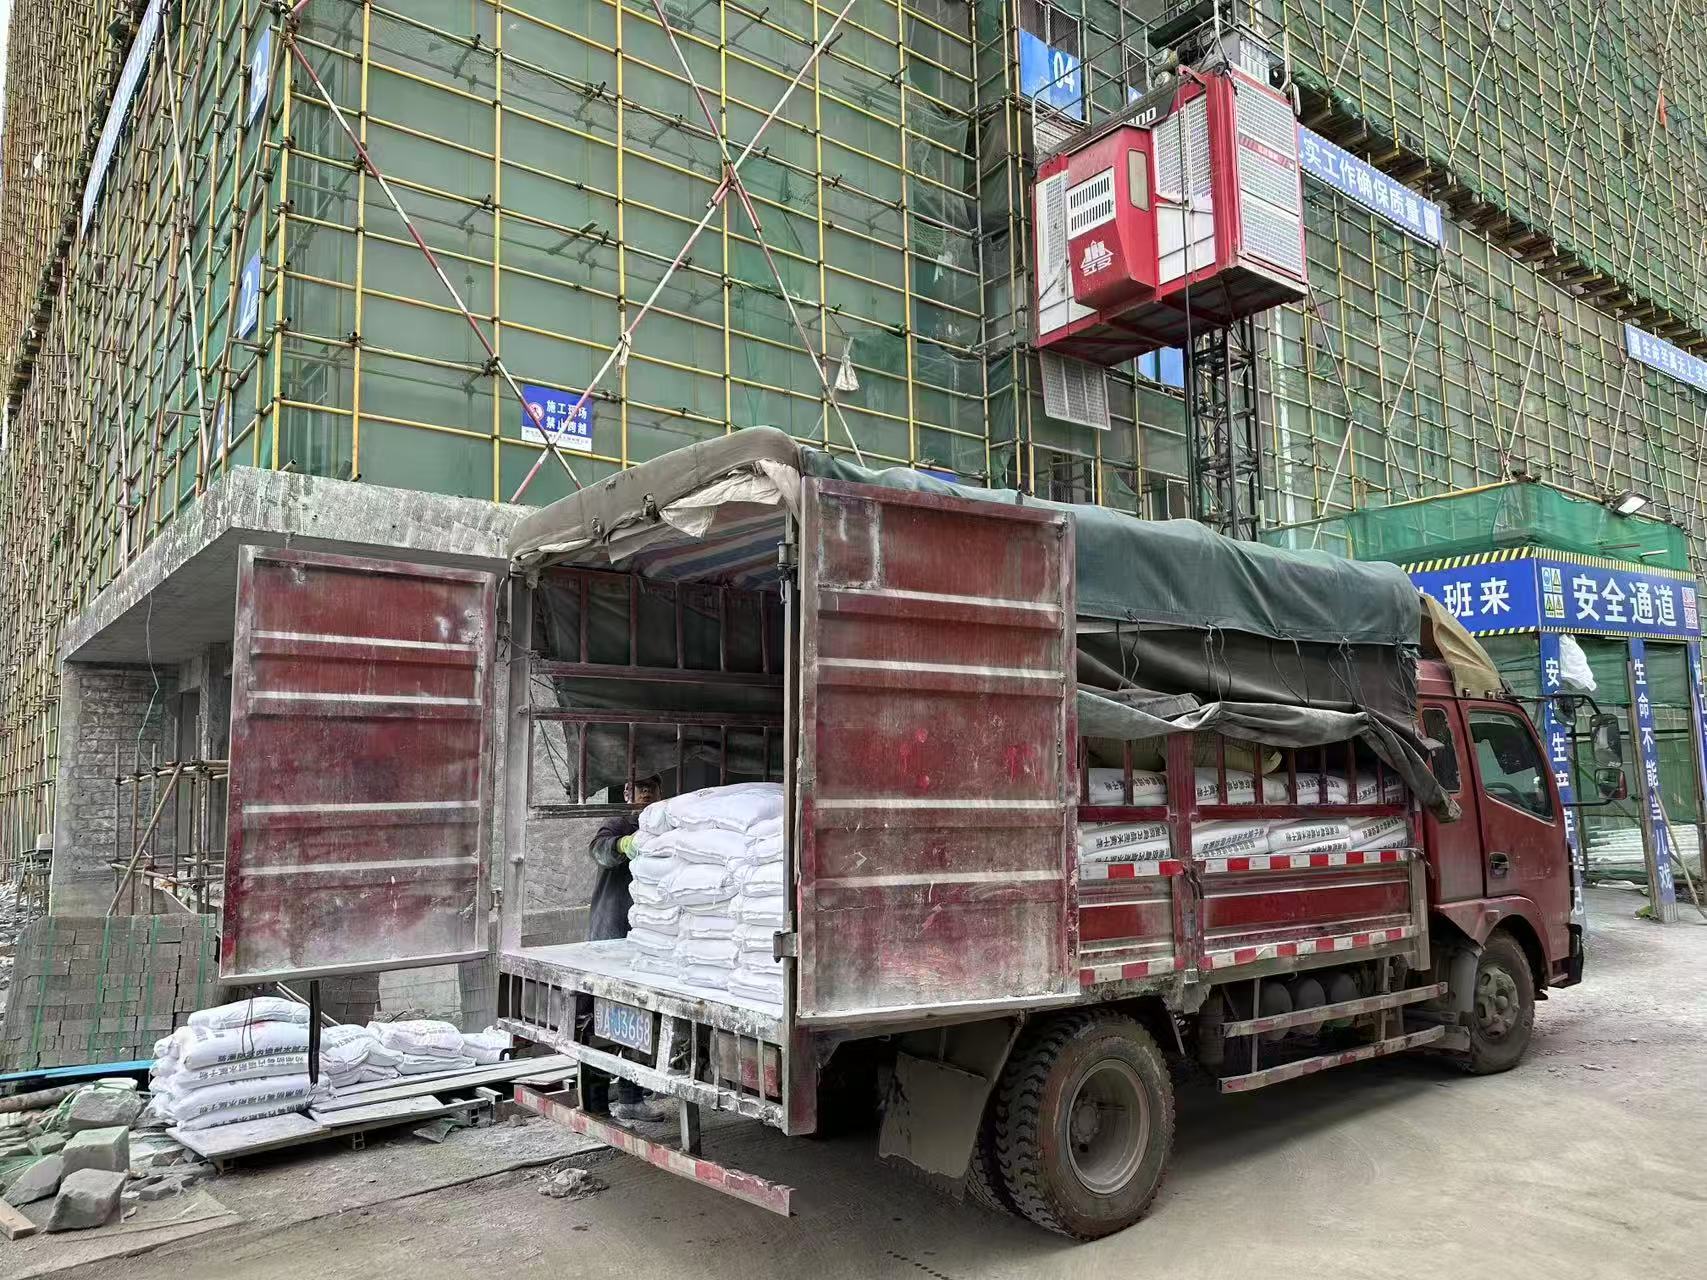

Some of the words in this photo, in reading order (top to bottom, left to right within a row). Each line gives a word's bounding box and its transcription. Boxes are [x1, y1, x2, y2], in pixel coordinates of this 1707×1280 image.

[1053, 51, 1075, 94] 04
[1299, 137, 1422, 228] 实工作确保质量
[1419, 576, 1511, 619] 班来
[1572, 573, 1677, 627] 安全通道
